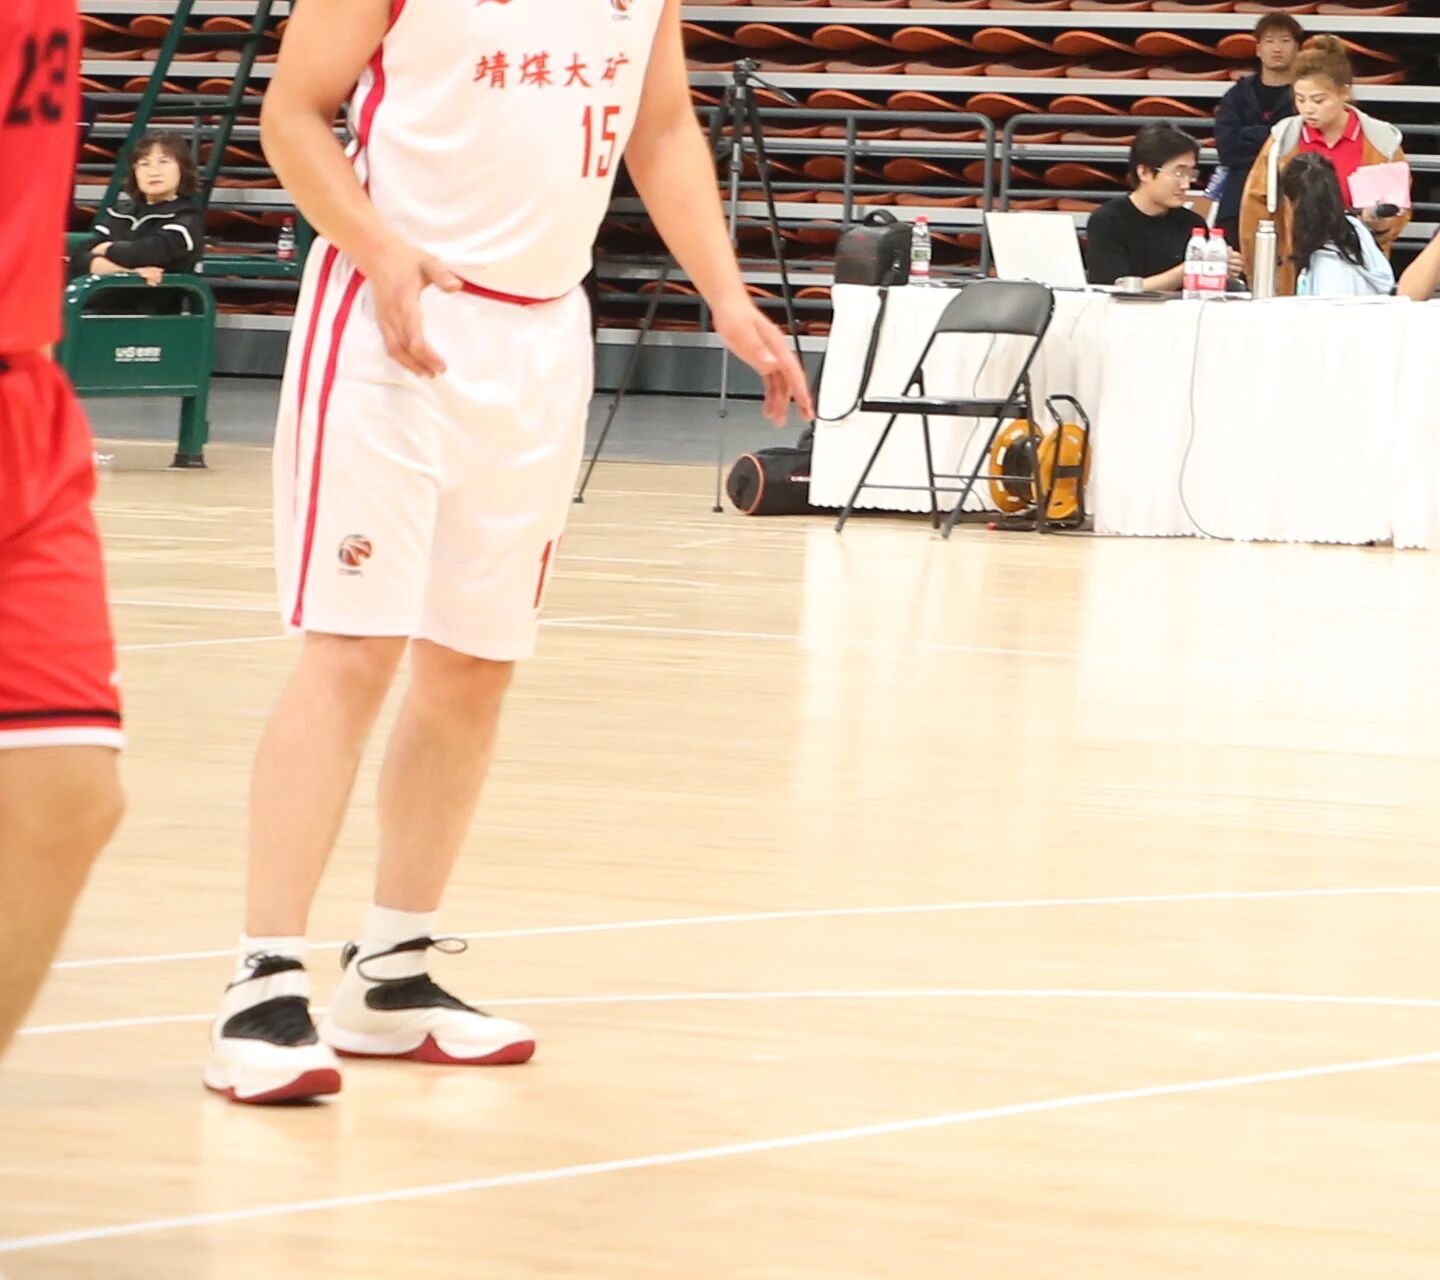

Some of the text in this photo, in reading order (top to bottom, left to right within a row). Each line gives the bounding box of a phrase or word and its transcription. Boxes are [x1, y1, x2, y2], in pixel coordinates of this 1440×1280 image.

[473, 50, 631, 89] 靖煤大矿
[581, 105, 621, 178] 15
